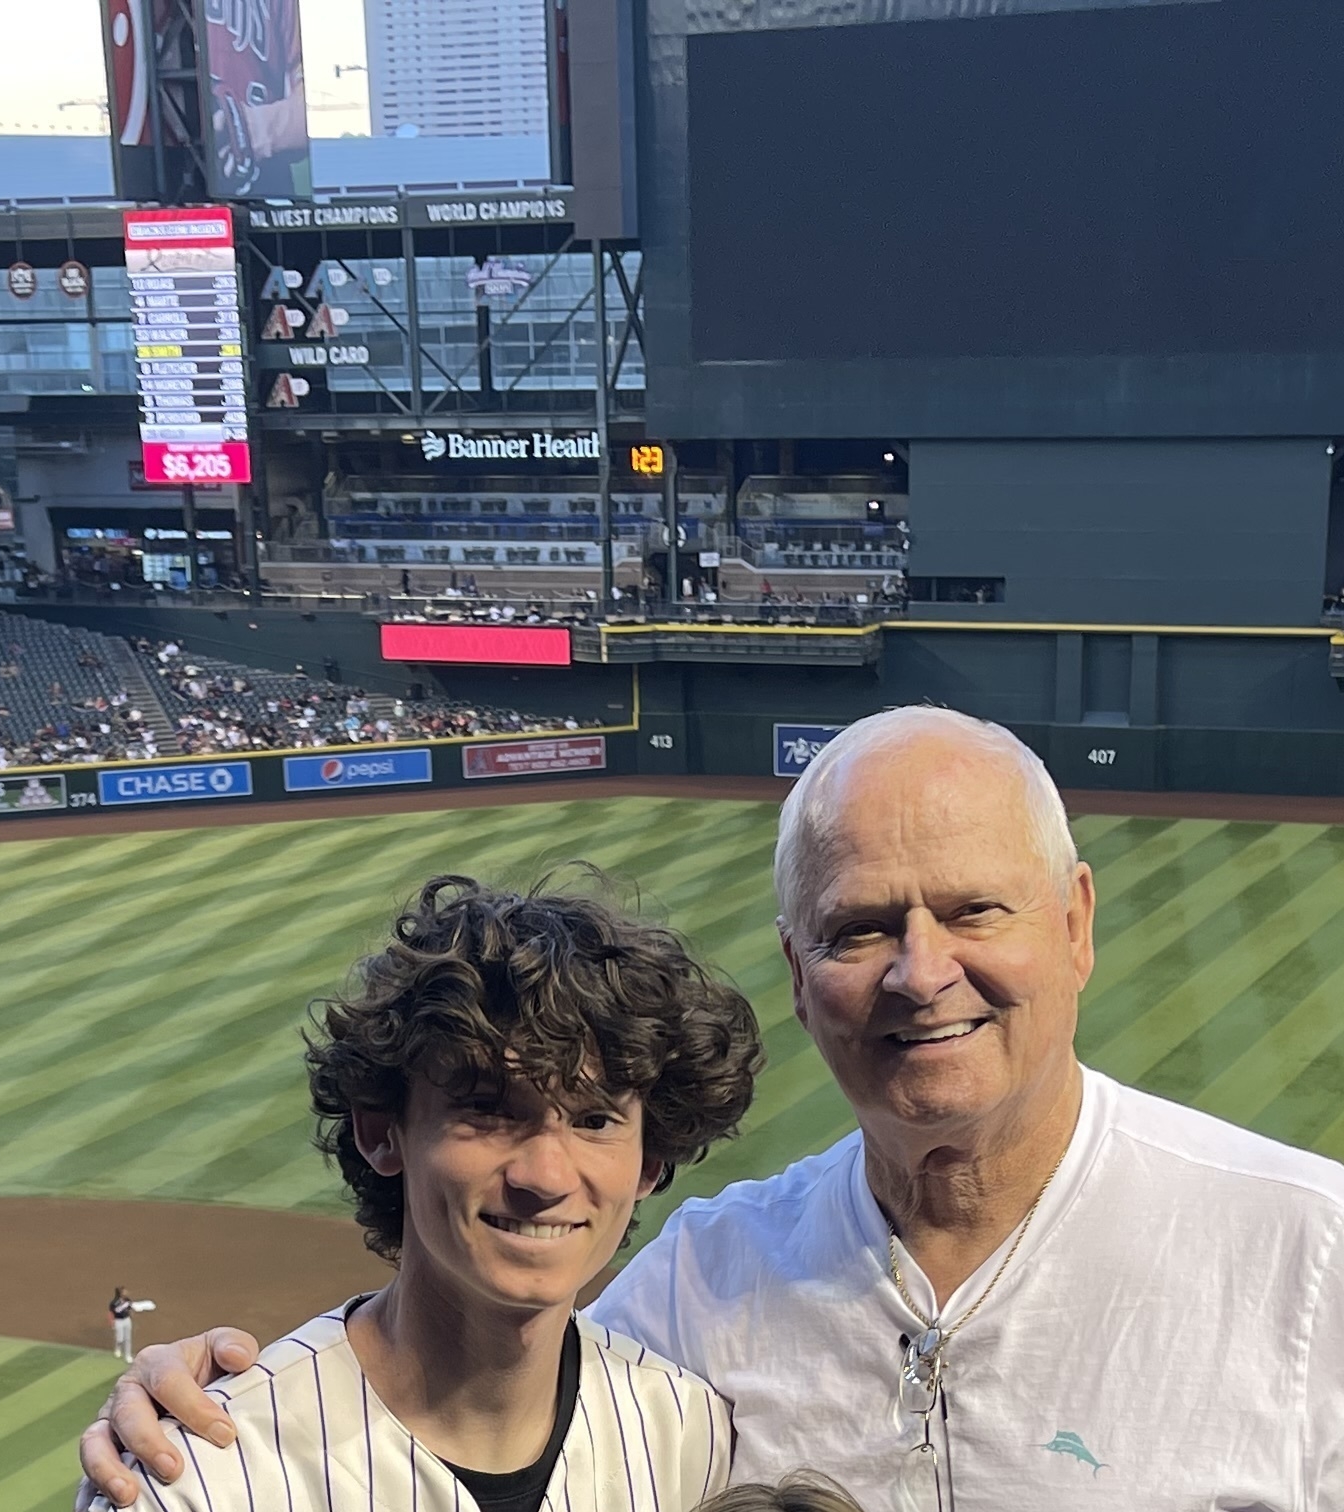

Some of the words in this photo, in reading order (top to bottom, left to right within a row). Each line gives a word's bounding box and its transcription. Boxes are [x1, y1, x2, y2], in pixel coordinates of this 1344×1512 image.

[272, 208, 311, 227] WEST
[313, 205, 399, 226] CHAMPIONS
[426, 203, 478, 222] WORLD
[479, 199, 566, 220] CHAMPIONS
[289, 346, 328, 366] WILD
[329, 346, 370, 365] CARD
[447, 433, 530, 459] Banner
[162, 453, 232, 480] $6,205
[649, 734, 673, 749] 413
[1087, 749, 1116, 765] 407
[347, 757, 396, 780] pepsi
[117, 772, 206, 797] CHASE
[69, 792, 98, 808] 374
